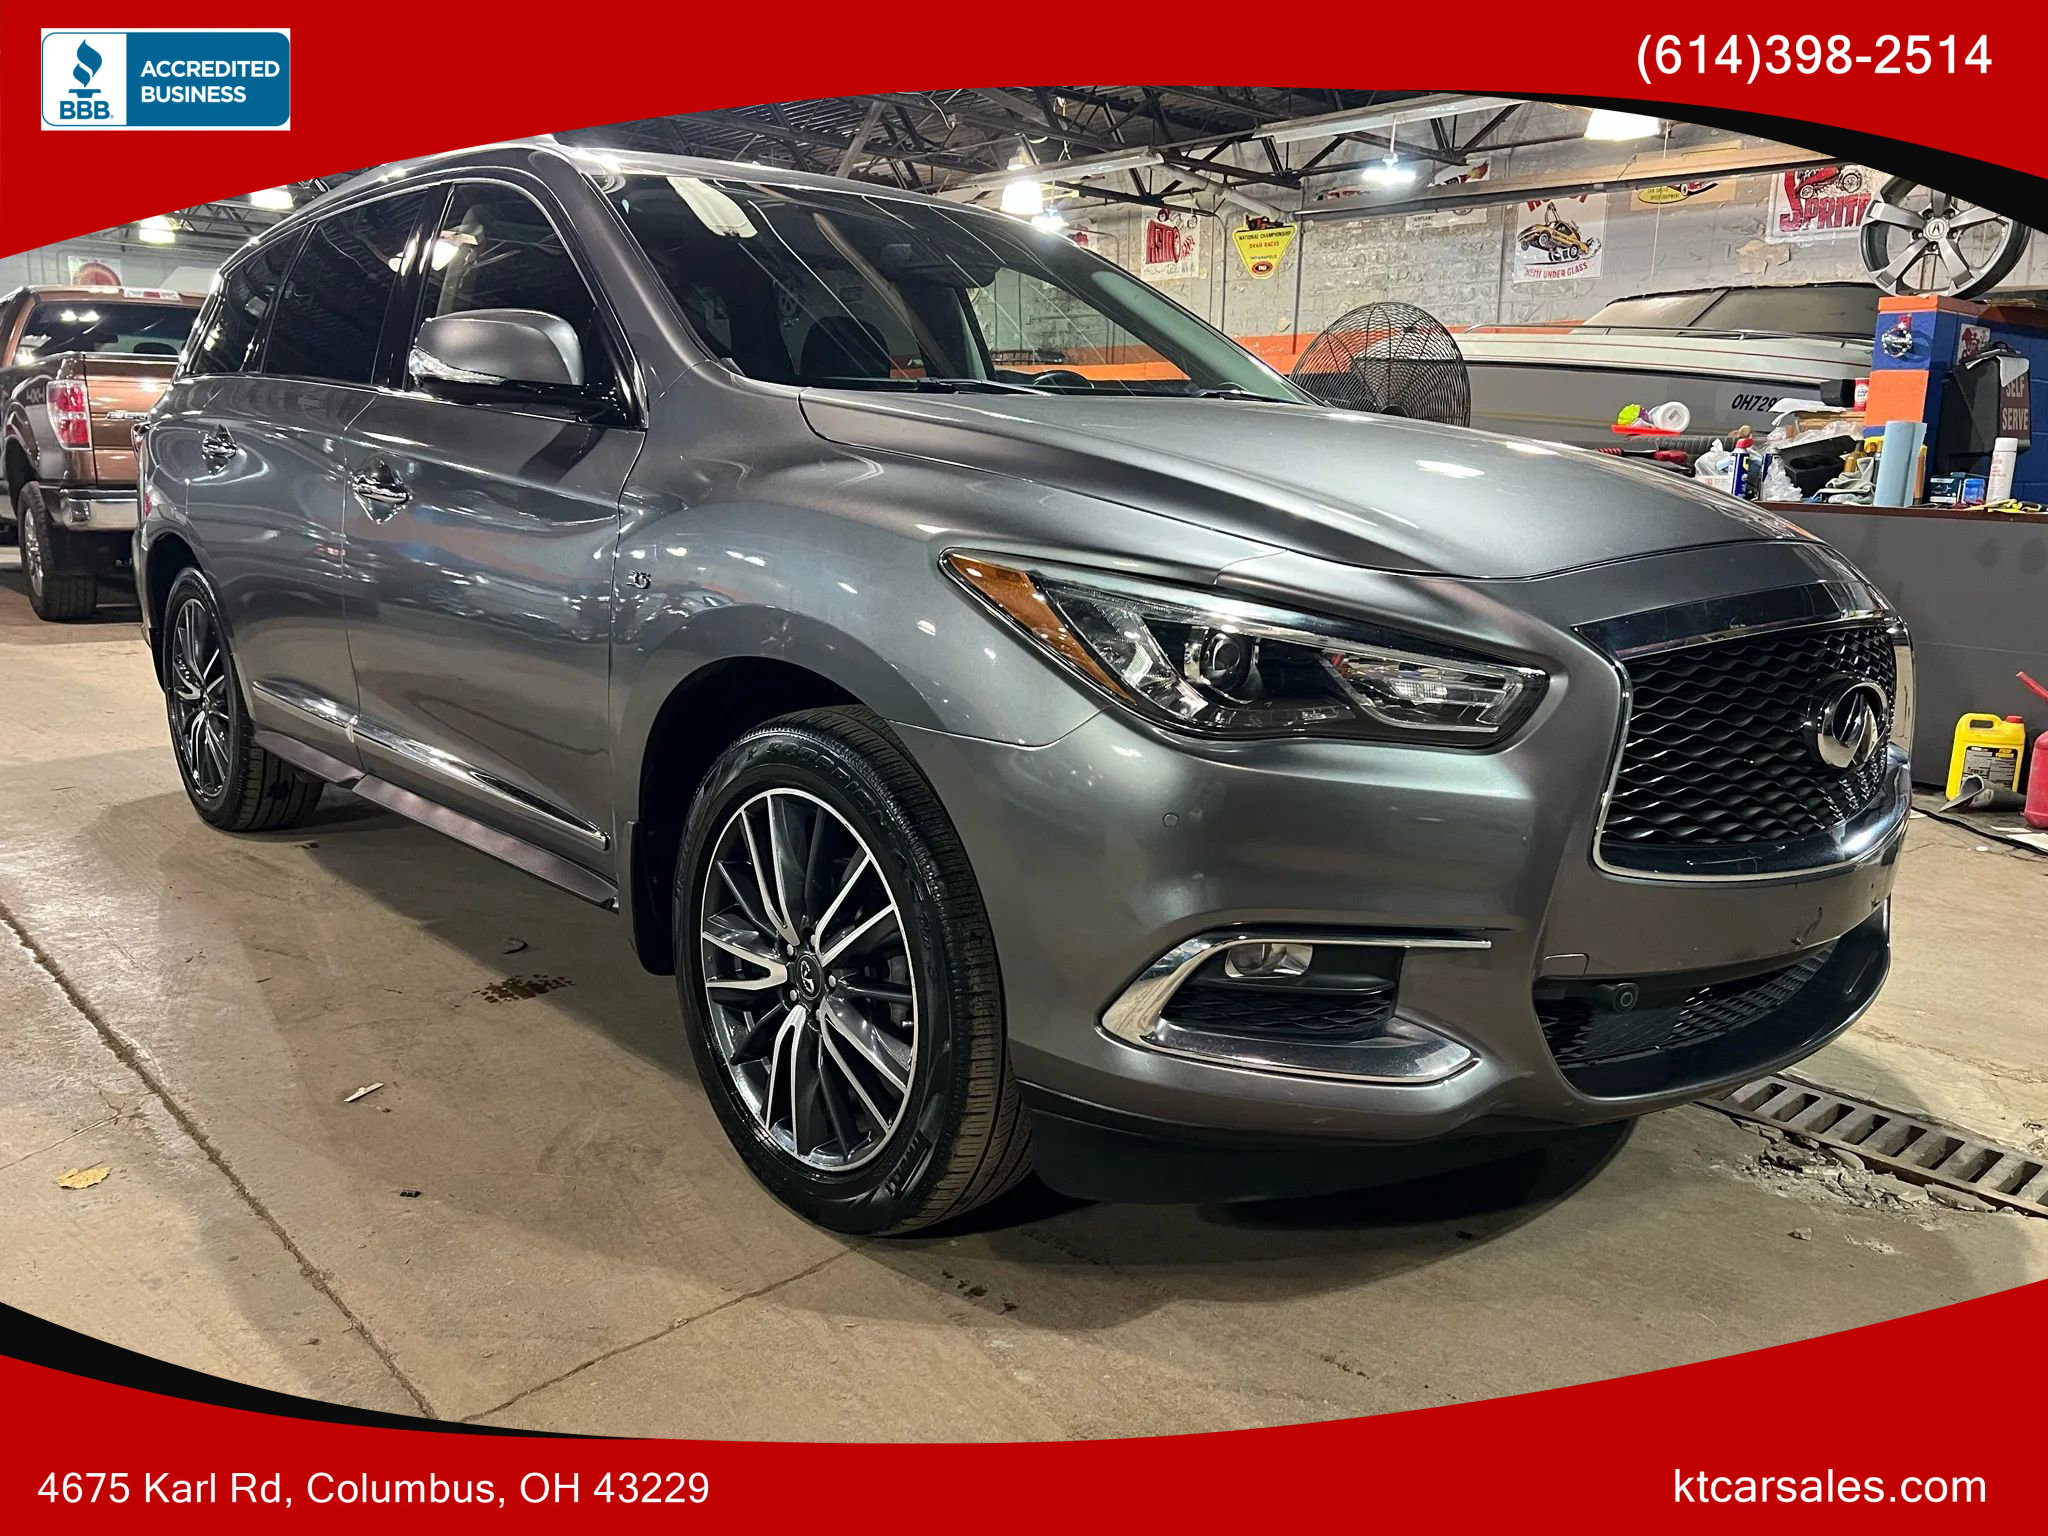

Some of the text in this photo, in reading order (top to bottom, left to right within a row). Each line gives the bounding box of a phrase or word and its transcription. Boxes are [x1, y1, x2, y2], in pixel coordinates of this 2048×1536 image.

[1543, 269, 1566, 279] UNDER
[2006, 376, 2025, 398] SELF
[2002, 407, 2029, 431] SERVE
